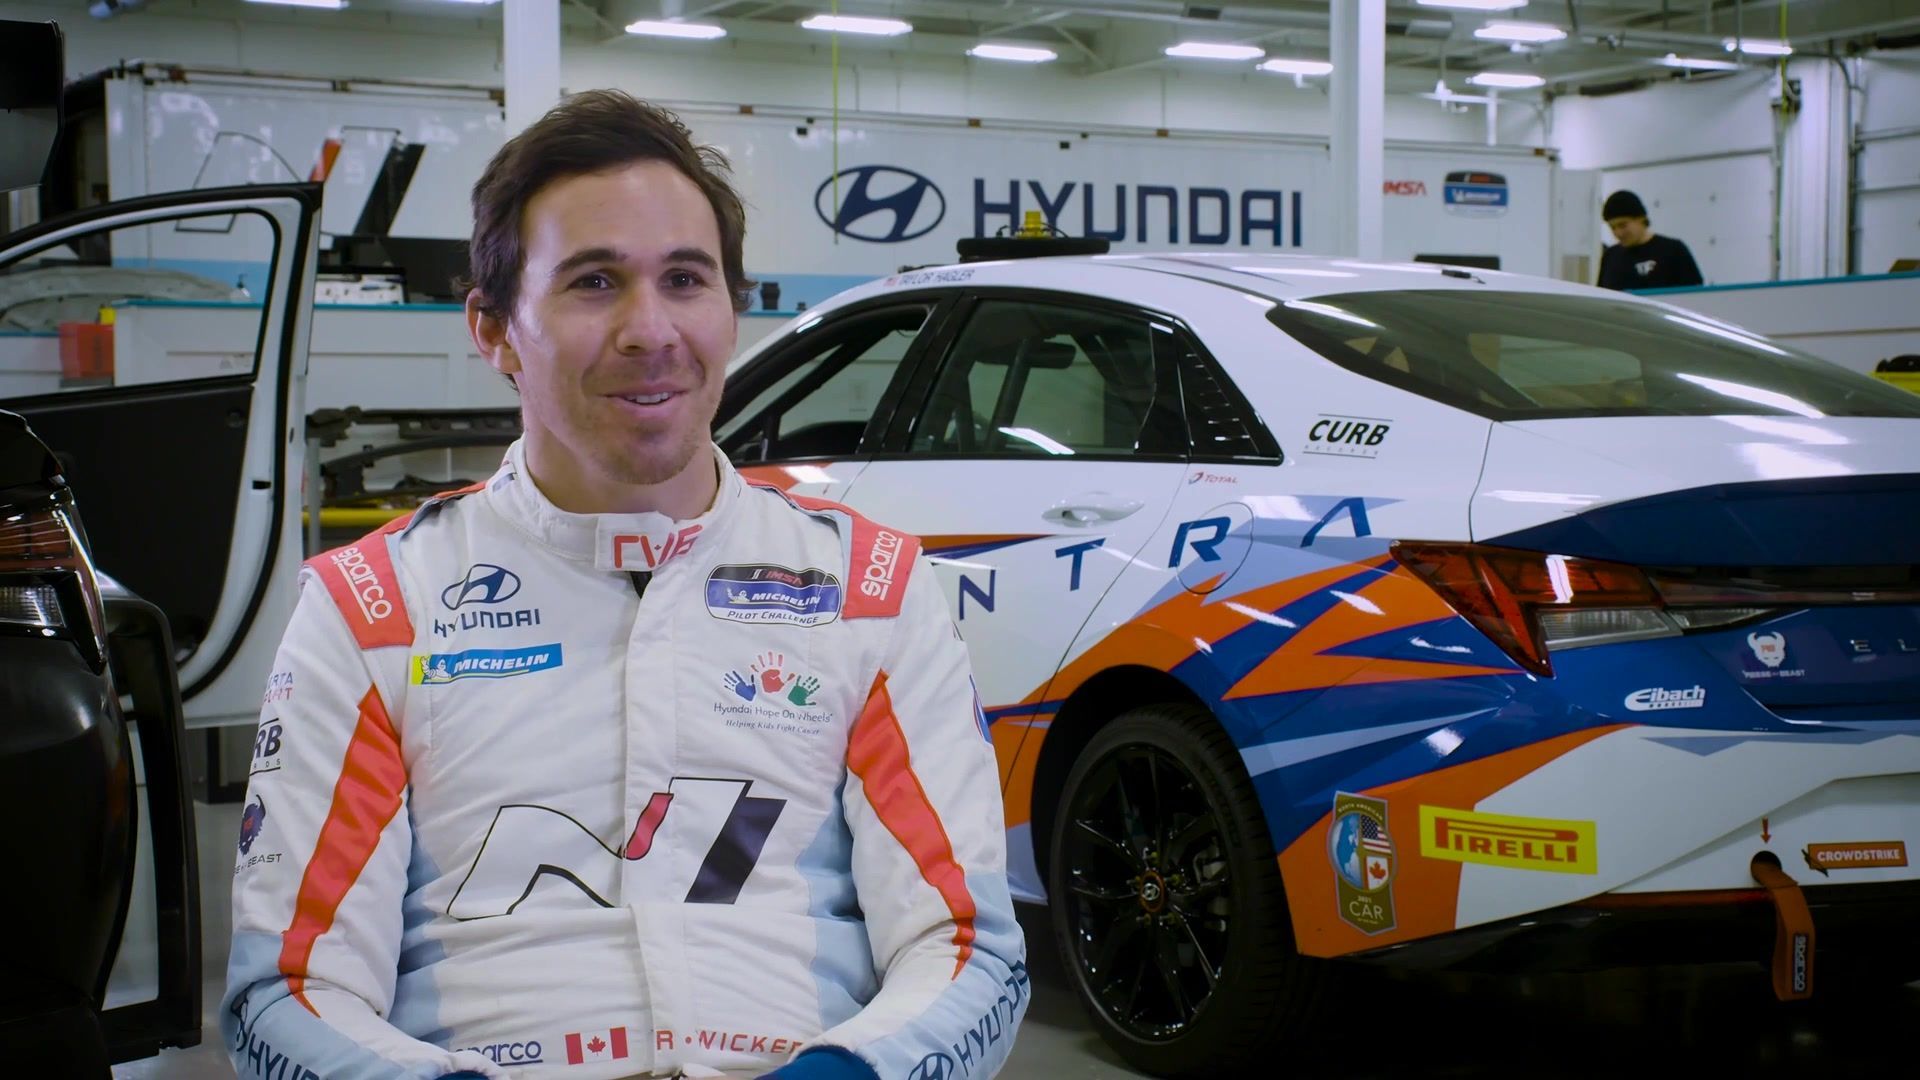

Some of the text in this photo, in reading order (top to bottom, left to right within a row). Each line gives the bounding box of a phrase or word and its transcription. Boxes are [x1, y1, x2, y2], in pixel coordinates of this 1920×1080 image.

[974, 179, 1302, 247] HYUNDAI
[1308, 420, 1390, 446] CURB
[1203, 474, 1238, 484] TOTAL
[860, 530, 903, 600] sparco
[331, 547, 392, 625] sparco
[765, 571, 803, 586] IMSA
[751, 592, 821, 607] MICHELIN
[434, 608, 541, 638] HYUNDAI
[728, 610, 819, 625] PILOT CHALLENGE
[453, 652, 550, 673] MICHELIN
[1624, 685, 1706, 711] Eibach
[713, 702, 752, 716] Hyundai
[755, 706, 780, 719] Hope
[782, 709, 795, 720] On
[726, 719, 755, 730] Helping
[757, 721, 774, 730] Kids
[254, 724, 283, 758] RB
[1434, 816, 1579, 863] PIRELLI
[1817, 848, 1900, 862] CROWDSTRIKE
[1349, 901, 1384, 920] CAR
[455, 1041, 543, 1066] arco
